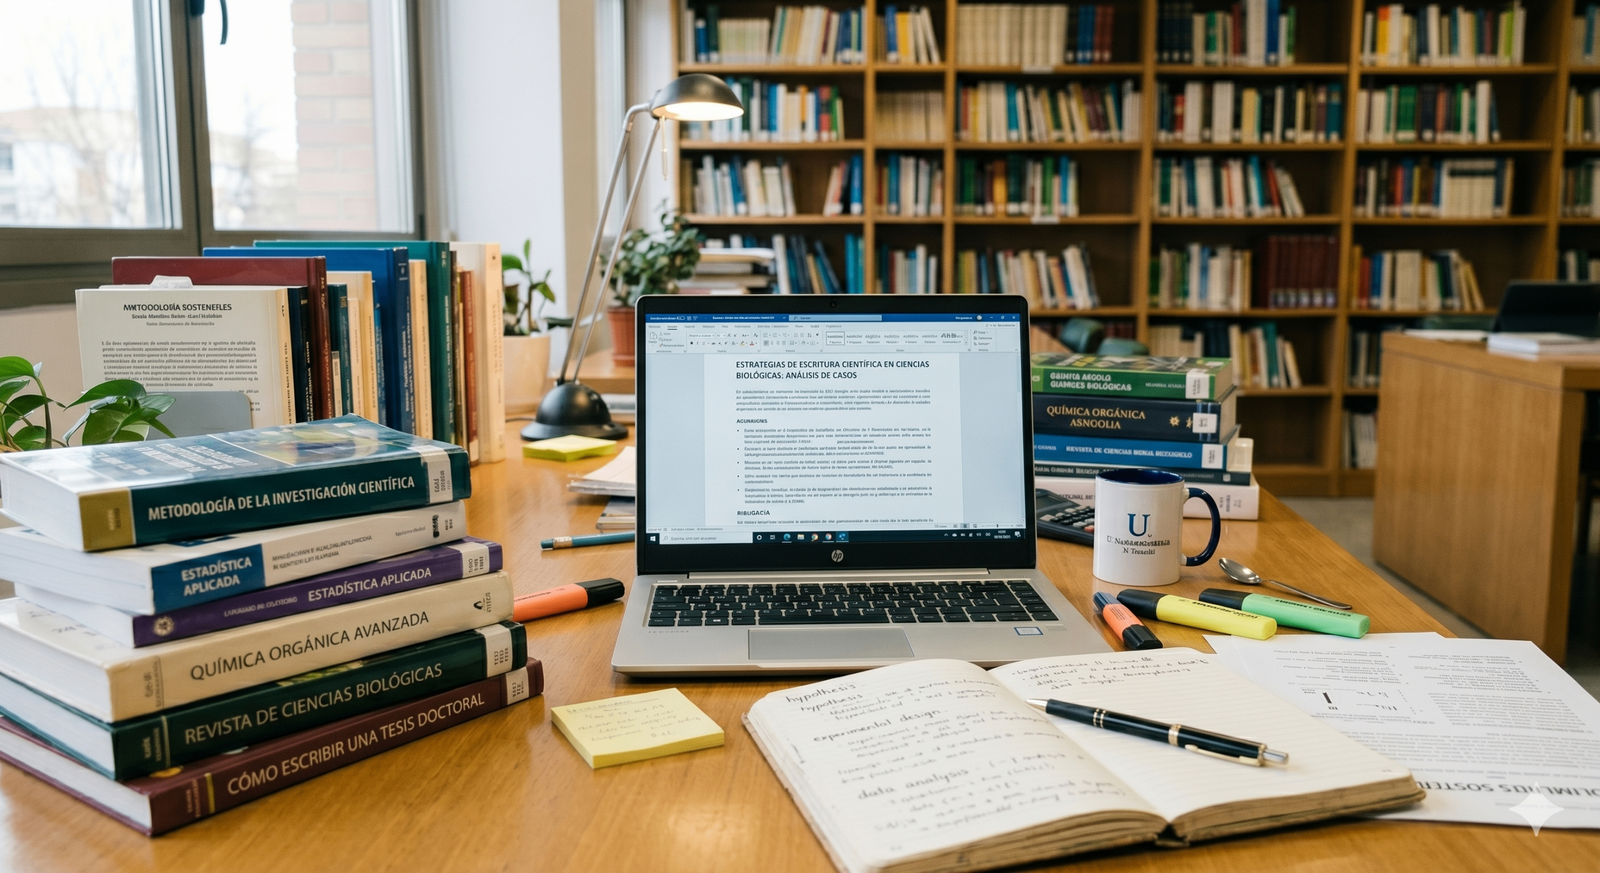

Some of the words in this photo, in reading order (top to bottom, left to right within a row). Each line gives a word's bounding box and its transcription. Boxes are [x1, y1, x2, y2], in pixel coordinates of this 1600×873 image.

[842, 359, 883, 368] CIENTÍFICA
[884, 360, 894, 368] EN
[896, 360, 930, 368] CIENCIAS
[785, 370, 820, 379] ANÁLISIS
[1087, 382, 1132, 391] BIOLÓGICAS
[1046, 404, 1090, 417] QUÍMICA
[1092, 407, 1146, 420] ORGÁNICA
[1094, 446, 1102, 454] DE
[1104, 447, 1132, 456] CIENCIAS
[148, 498, 236, 522] METODOLOGÍA
[238, 495, 253, 510] DE
[256, 493, 270, 508] LA
[272, 480, 357, 505] INVESTIGACIÓN
[358, 474, 415, 495] CIENTÍFICA
[832, 550, 843, 562] hp
[180, 556, 253, 582] ESTADÍSTICA
[184, 574, 241, 596] APLICADA
[308, 578, 379, 602] ESTADÍSTICA
[380, 567, 432, 588] APLICADA
[190, 652, 266, 682] QUÍMICA
[268, 628, 351, 661] ORGÁNICA
[354, 610, 430, 640] AVANZADA
[184, 714, 253, 745] REVISTA
[256, 708, 278, 724] DE
[282, 686, 353, 719] CIENCIAS
[356, 662, 443, 698] BIOLÓGICAS
[900, 709, 941, 723] design
[227, 763, 279, 796] CÓMO
[282, 740, 345, 776] ESCRIBIR
[348, 729, 379, 753] UNA
[380, 718, 416, 741] TESIS
[418, 692, 486, 727] DOCTORAL
[906, 768, 969, 789] analysis
